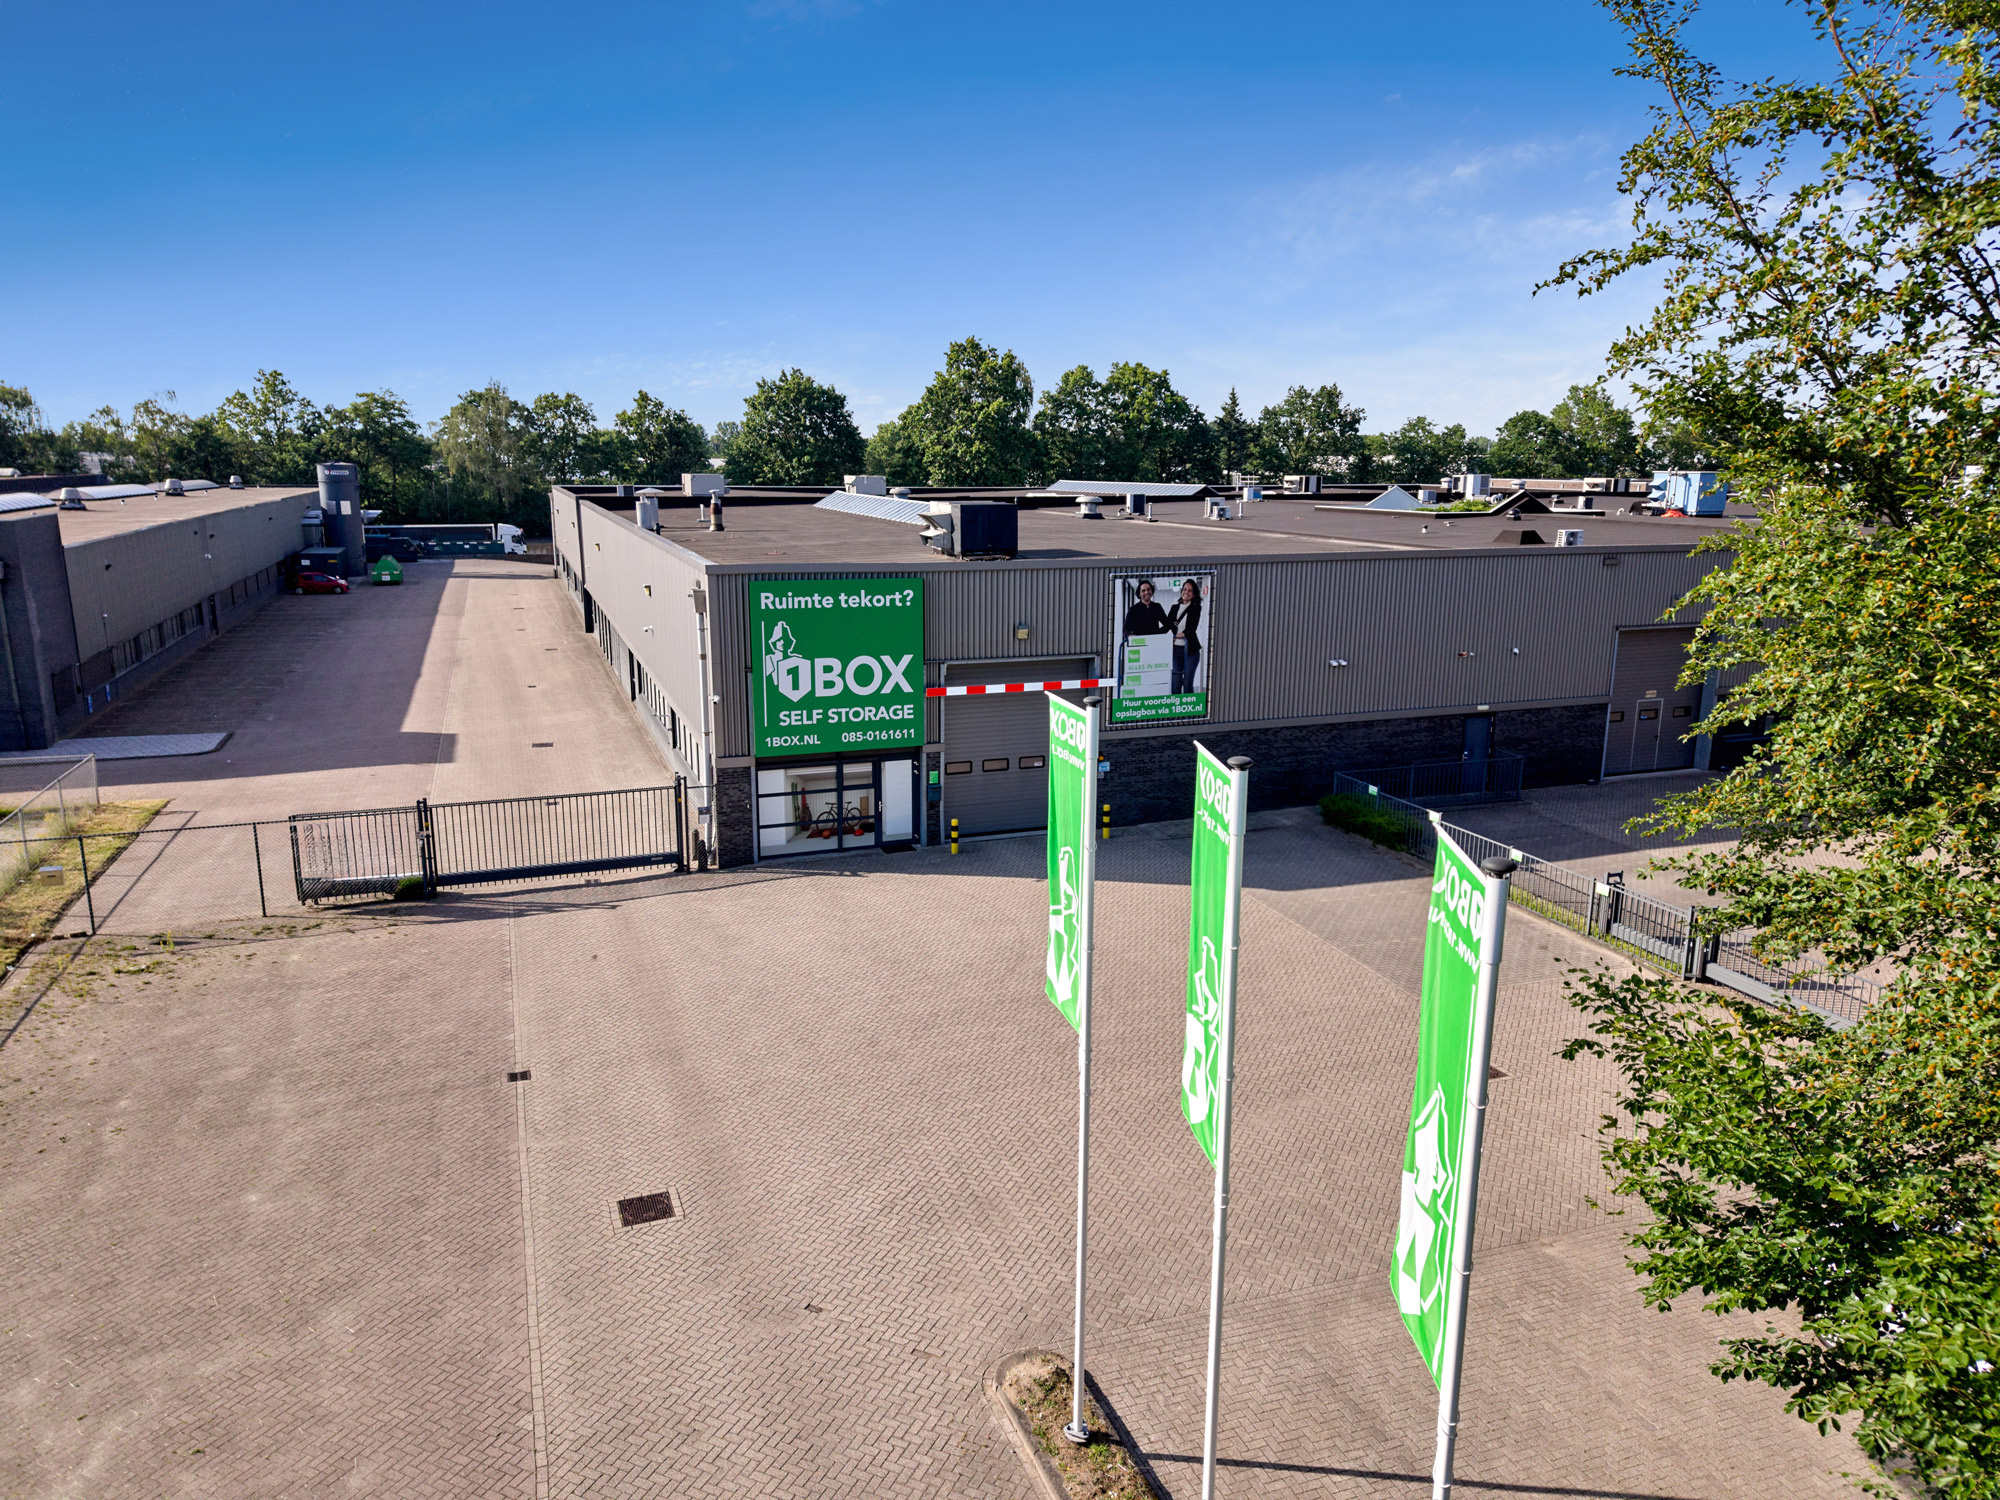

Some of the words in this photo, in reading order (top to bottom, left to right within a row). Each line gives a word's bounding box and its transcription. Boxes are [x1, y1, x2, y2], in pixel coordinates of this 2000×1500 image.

[760, 592, 834, 610] Ruimte
[839, 589, 914, 608] tekort?
[784, 654, 914, 698] 1BOX
[1115, 708, 1156, 719] opslagbox
[1158, 706, 1169, 714] via
[1171, 703, 1203, 713] 1BOX.nl
[1122, 699, 1142, 707] Huur
[1144, 696, 1180, 705] voordelig
[779, 709, 824, 726] SELF
[827, 704, 914, 724] STORAGE
[765, 734, 821, 748] 1BOX.NL
[841, 729, 915, 742] 085-0161611
